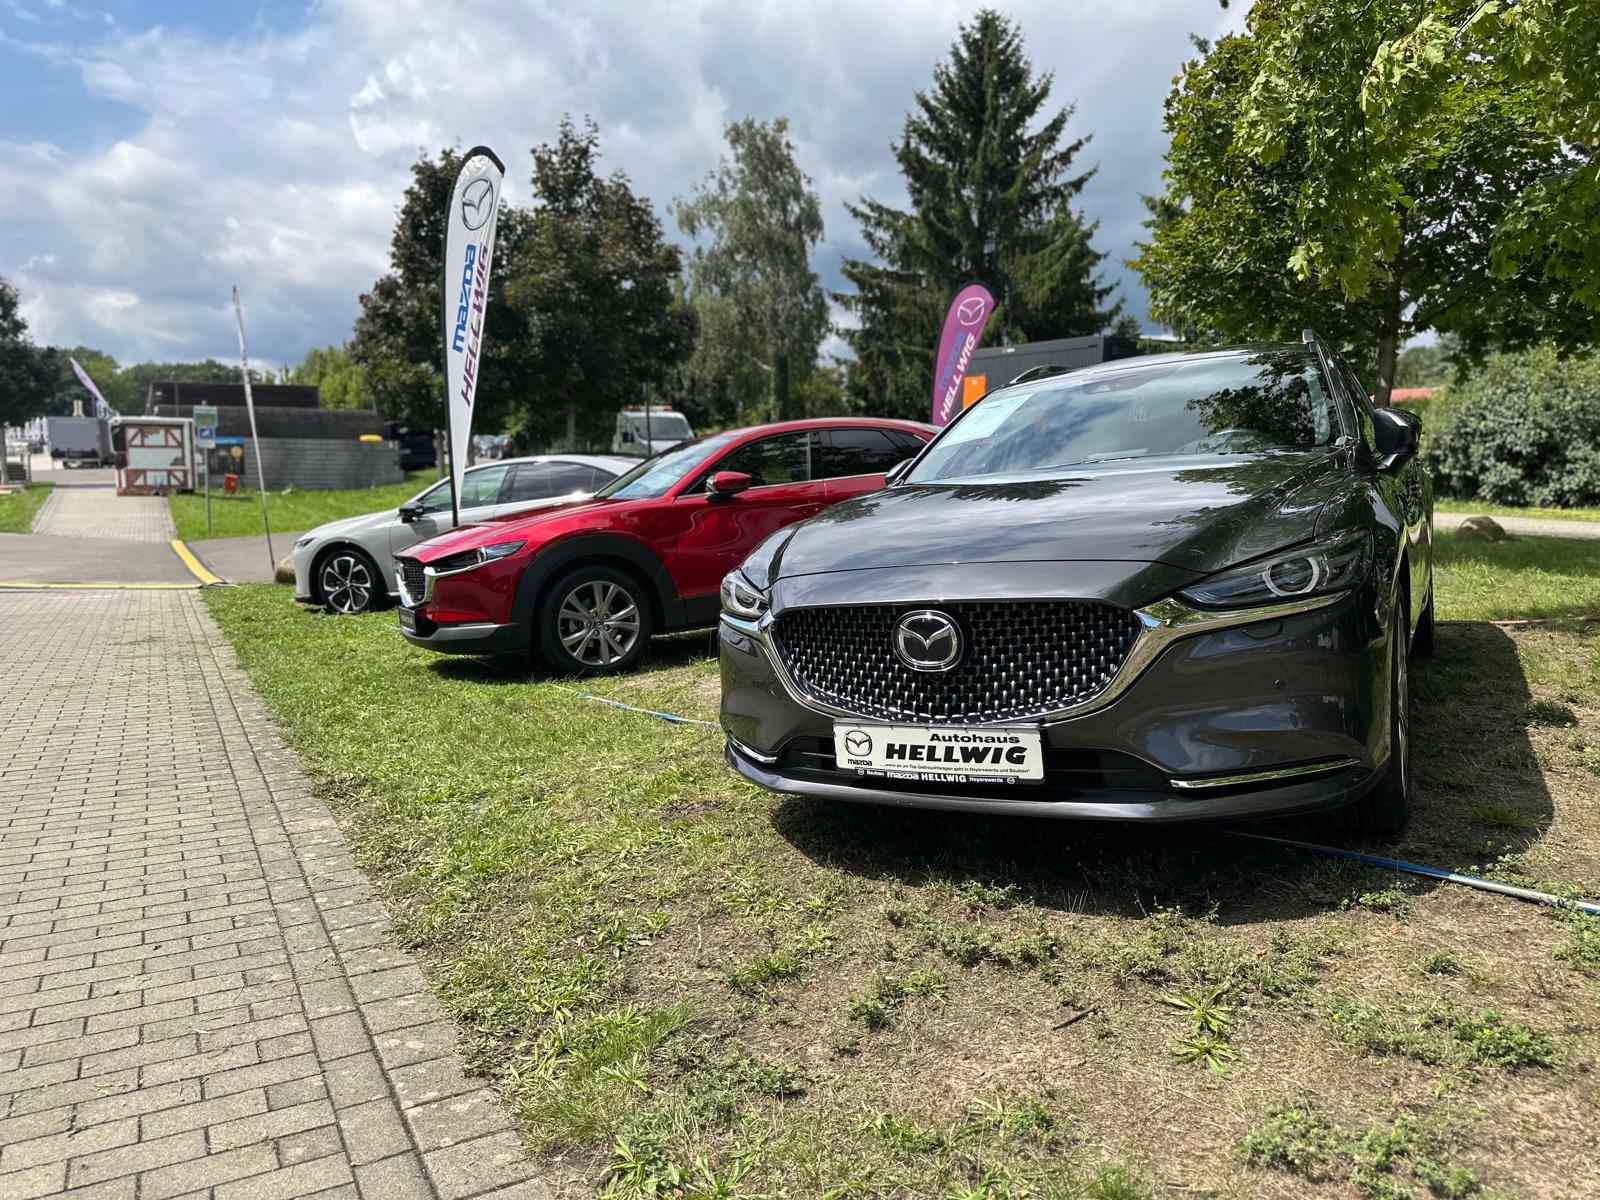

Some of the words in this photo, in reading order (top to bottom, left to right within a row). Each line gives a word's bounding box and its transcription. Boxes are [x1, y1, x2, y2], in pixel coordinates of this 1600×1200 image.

[452, 243, 477, 353] mazda
[461, 241, 489, 407] HELLWIG
[940, 332, 976, 421] HELLWIG
[930, 733, 1020, 744] Autohaus
[848, 758, 872, 766] mazda
[885, 743, 1028, 765] HELLWIG
[886, 772, 919, 780] mazda
[921, 773, 967, 782] HELLWIG
